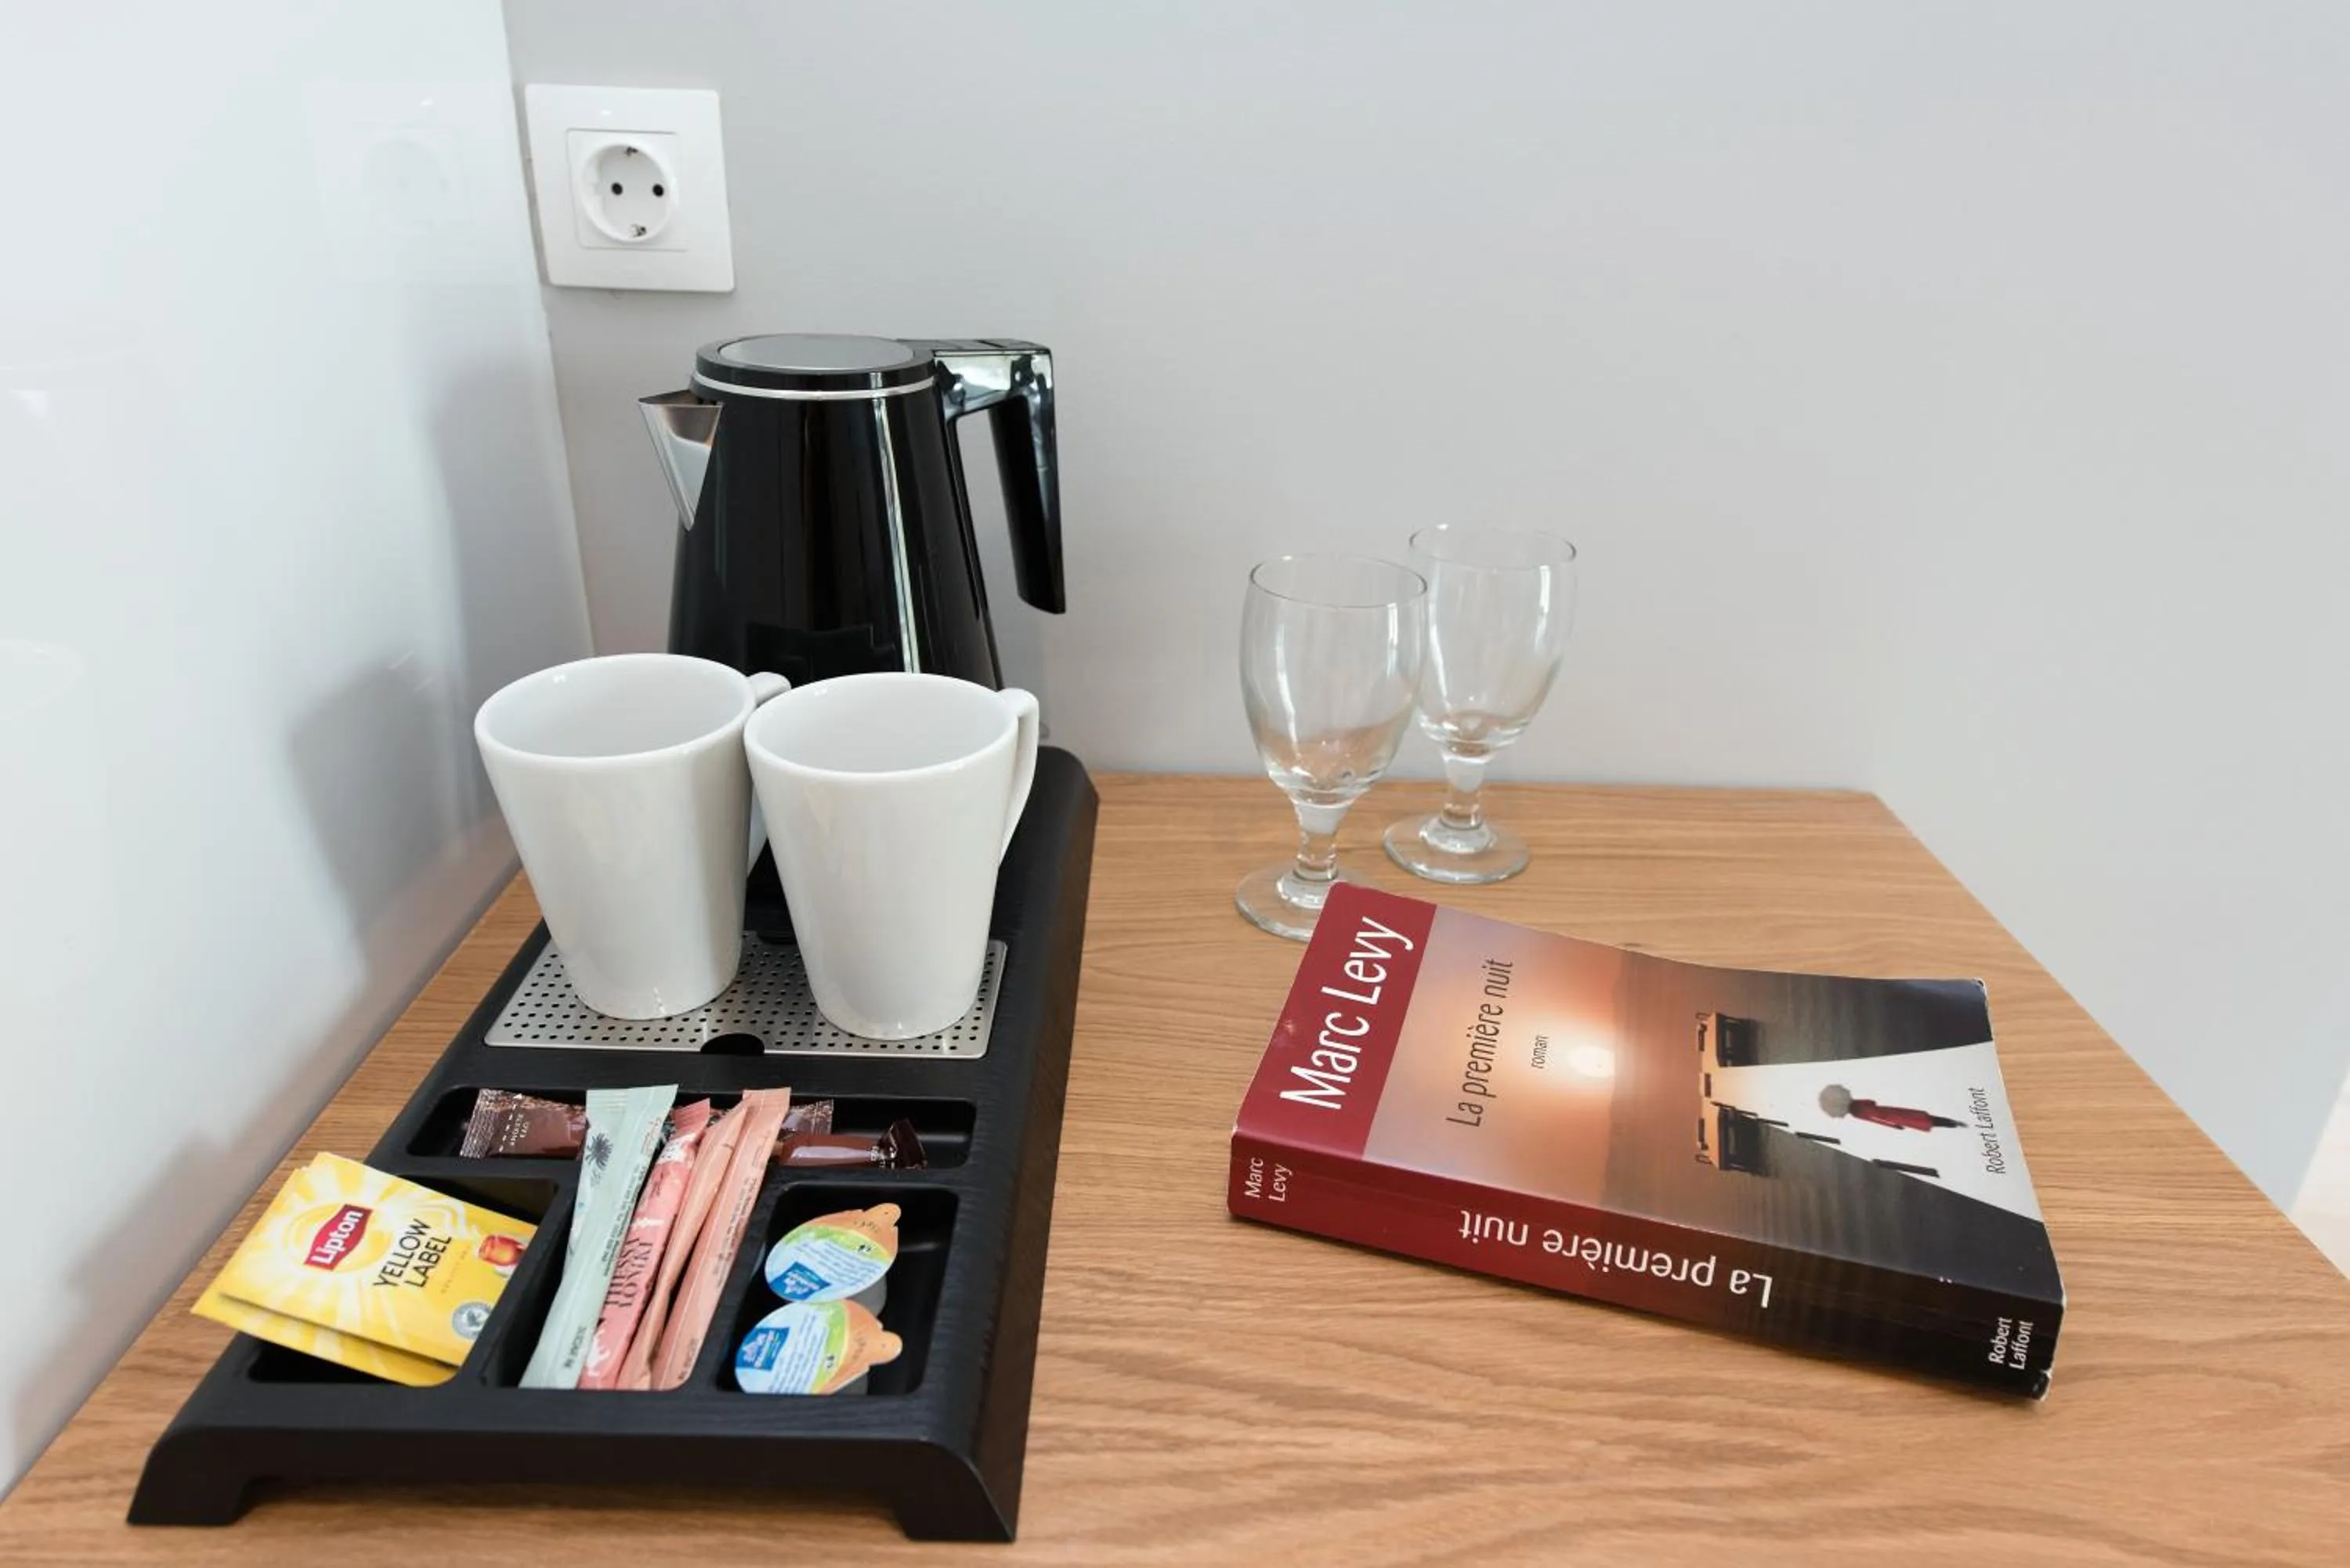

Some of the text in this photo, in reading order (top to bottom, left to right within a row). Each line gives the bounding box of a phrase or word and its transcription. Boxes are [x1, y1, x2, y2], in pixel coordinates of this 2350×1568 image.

[1279, 916, 1414, 1109] Marc Levy
[1446, 958, 1513, 1127] La première nuit
[1531, 1035, 1550, 1069] roman
[1969, 1087, 2005, 1175] Robert Laffont
[1245, 1158, 1264, 1198] Marc
[1269, 1164, 1292, 1202] Levy
[310, 1209, 364, 1266] Lipton
[373, 1218, 431, 1288] YELLOW
[406, 1235, 452, 1288] LABEL
[1459, 1210, 1773, 1309] La première nuit
[1988, 1317, 2012, 1364] Robert
[2008, 1321, 2034, 1371] Laffont
